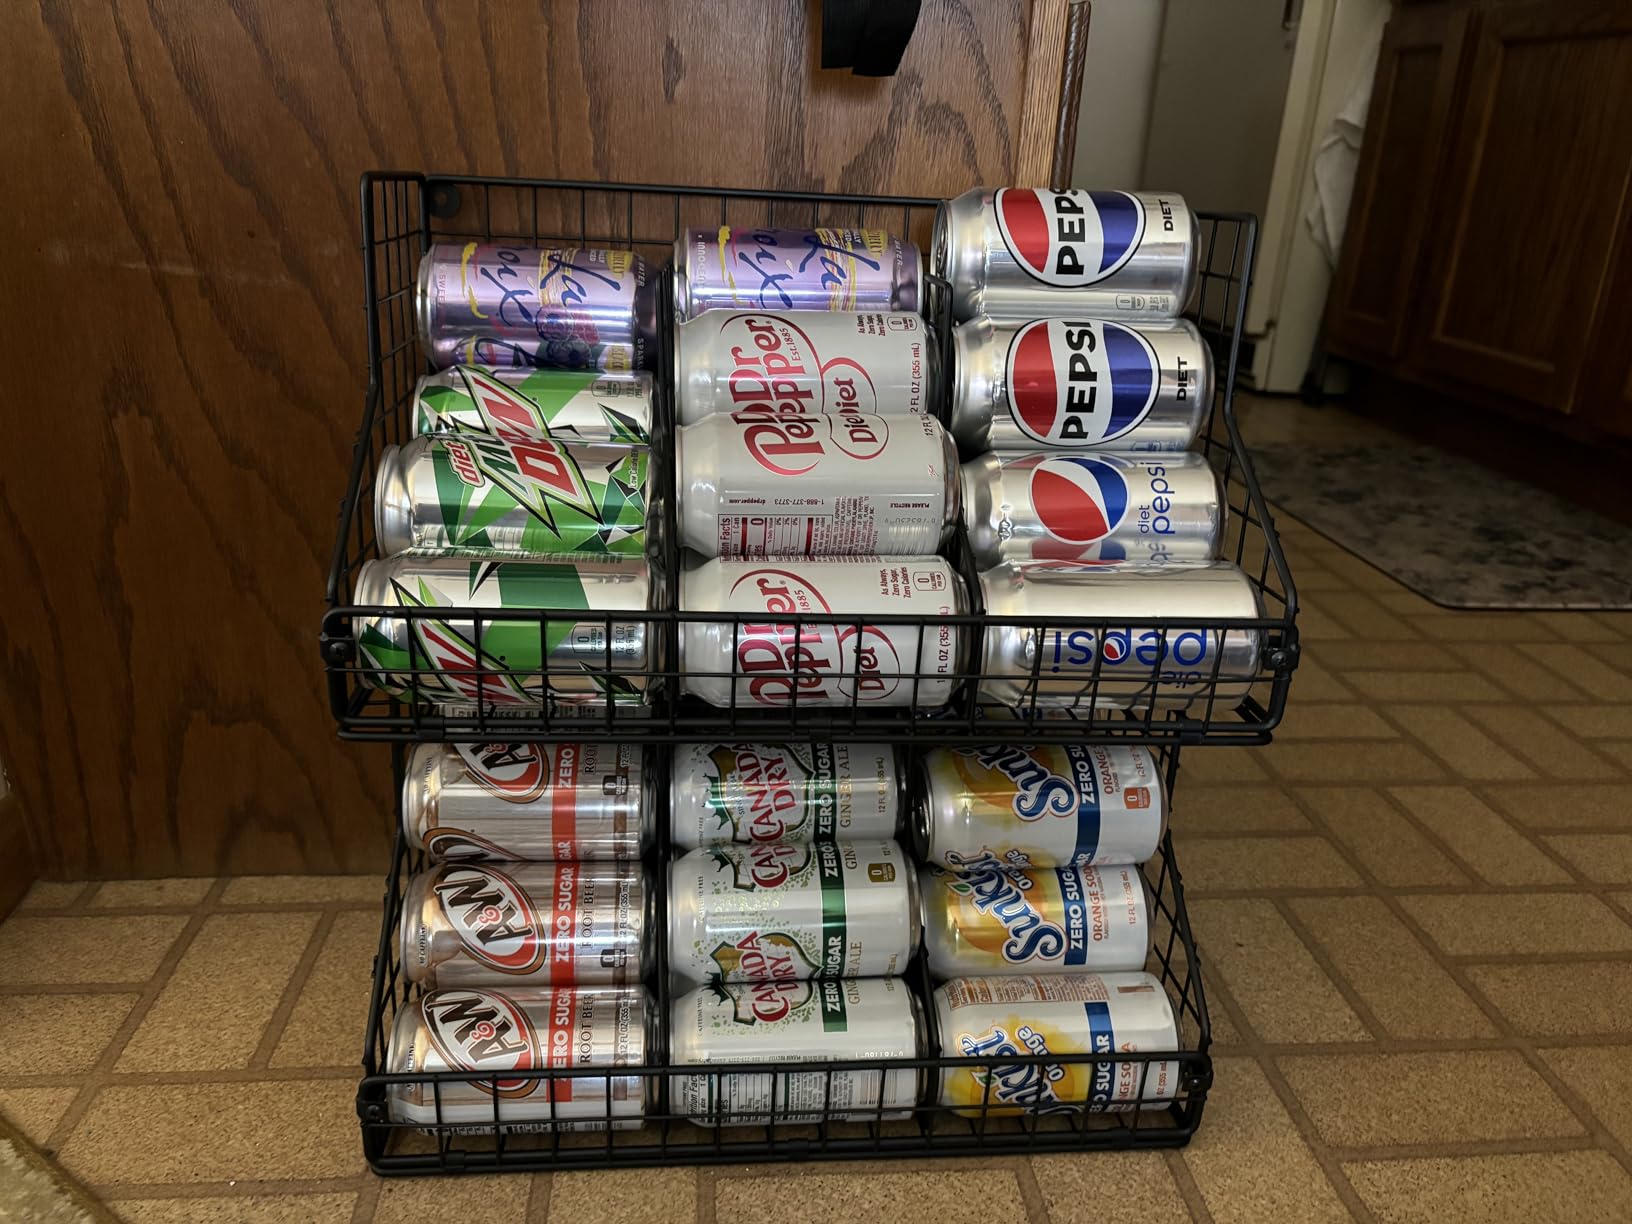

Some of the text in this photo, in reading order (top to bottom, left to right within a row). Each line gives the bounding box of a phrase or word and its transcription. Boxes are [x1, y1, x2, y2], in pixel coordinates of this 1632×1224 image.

[1159, 200, 1173, 231] DIET
[744, 319, 813, 413] epper
[911, 343, 921, 358] mL)
[728, 346, 771, 402] Dr
[911, 382, 919, 393] OZ
[912, 360, 922, 379] (355
[1059, 321, 1097, 439] PEPSI
[1176, 357, 1188, 400] DIET
[832, 377, 859, 413] iet
[911, 395, 919, 405] FL
[446, 442, 479, 481] diet
[1140, 462, 1175, 534] pepsi
[719, 518, 731, 540] Facts
[732, 517, 740, 529] Can
[751, 518, 765, 526] 0
[1137, 505, 1150, 533] diet
[891, 584, 900, 596] Zero
[900, 567, 911, 598] Zero Calories
[615, 626, 625, 635] OZ
[938, 650, 949, 661] OZ
[559, 748, 575, 788] ZERO
[761, 756, 797, 811] DRY
[1075, 761, 1095, 804] ZERO
[1096, 750, 1114, 794] ORANGE
[836, 746, 851, 828] GINGER ALE
[819, 794, 832, 834] ZERO
[878, 805, 886, 813] 12
[433, 875, 535, 945] A&W
[556, 867, 574, 962] ZERO SUGAR
[620, 894, 628, 908] (355
[1056, 867, 1084, 950] ZERO SUGA
[1088, 891, 1103, 941] ORANGE
[1128, 916, 1136, 925] 12
[826, 935, 842, 974] SUGAR
[850, 941, 862, 964] ALE
[826, 982, 841, 1012] ZERO
[424, 995, 529, 1062] A&W
[580, 993, 594, 1063] ROOT BEER
[620, 1034, 628, 1043] FL
[619, 1044, 628, 1054] 12
[1119, 1042, 1131, 1078] SOA
